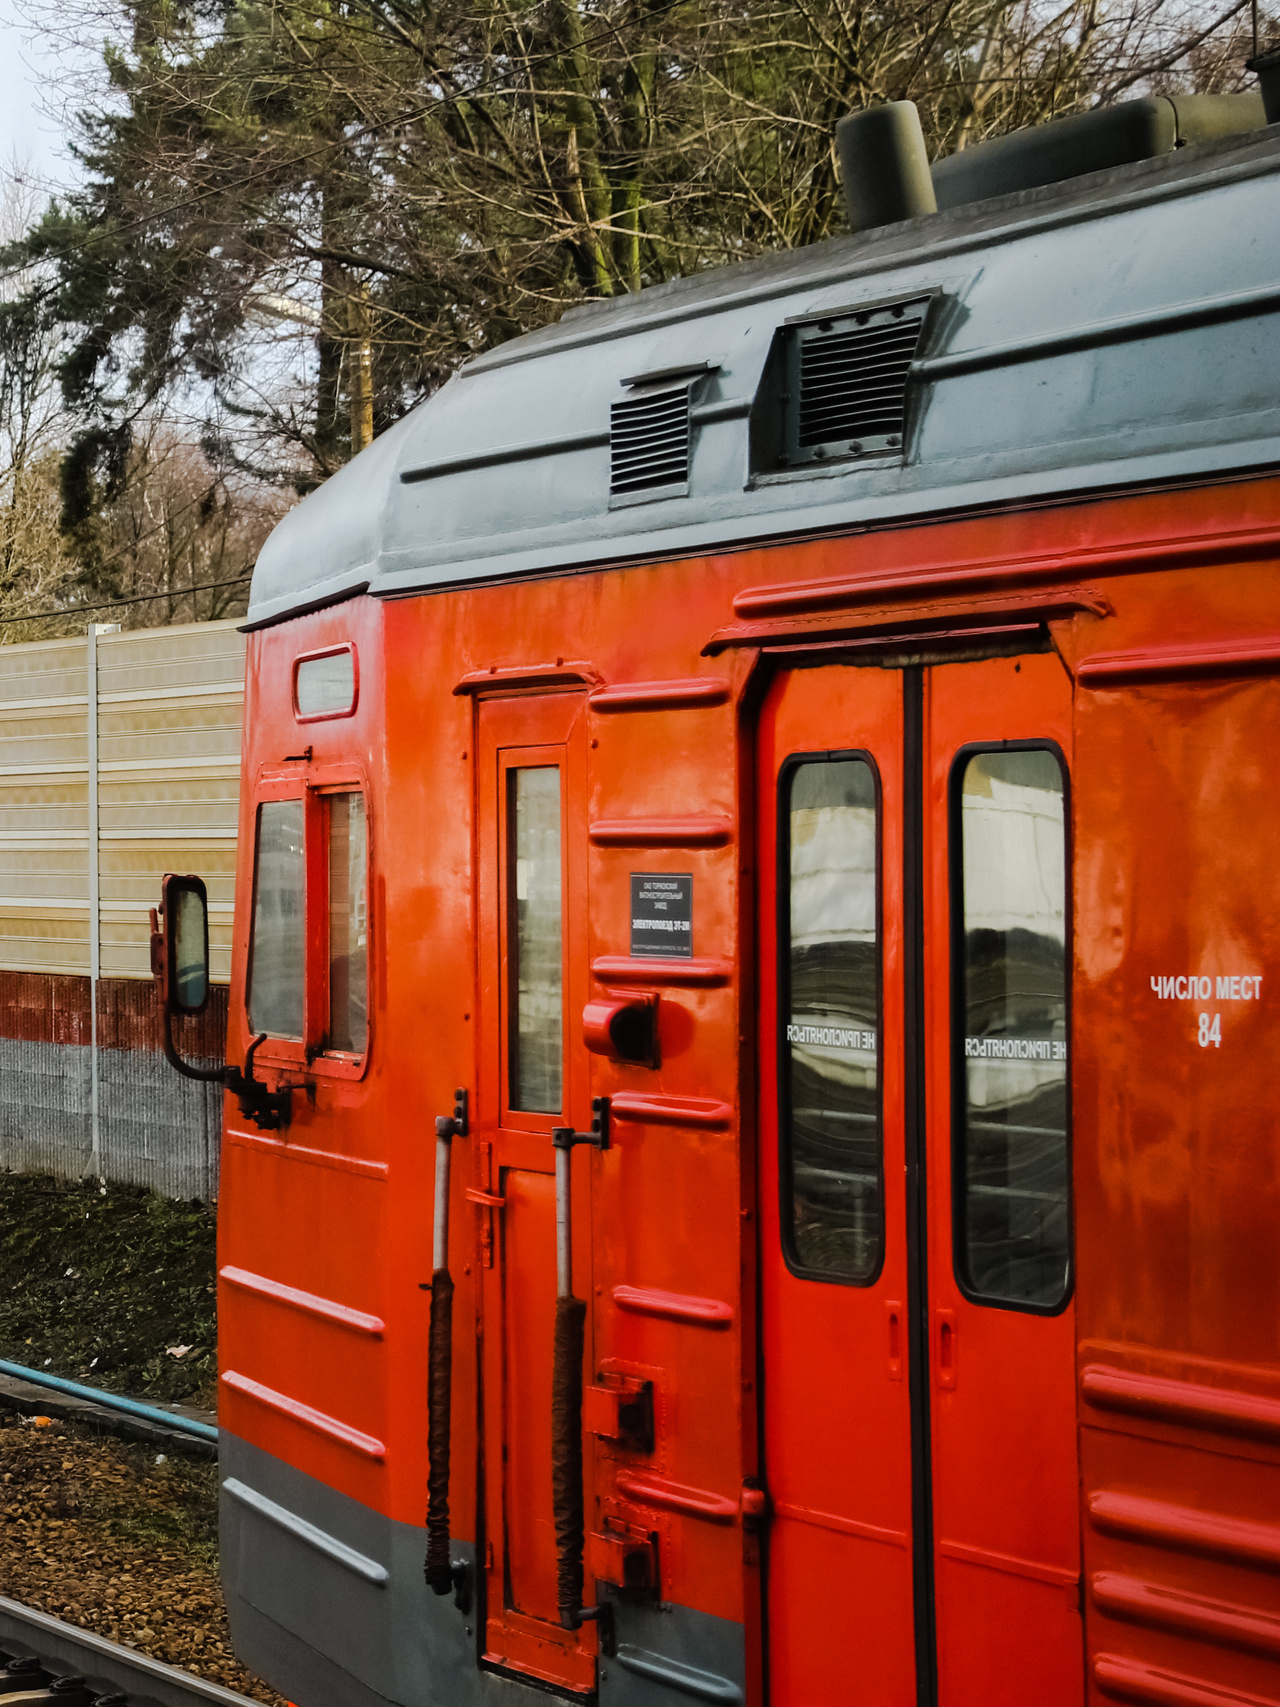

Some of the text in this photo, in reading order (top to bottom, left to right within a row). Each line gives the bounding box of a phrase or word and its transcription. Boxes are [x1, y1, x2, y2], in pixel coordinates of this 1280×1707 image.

[632, 918, 674, 932] ЭЛЕКТРОПОЕЗД
[1150, 975, 1263, 1000] ЧИСЛО МЕСТ
[1197, 1012, 1222, 1048] 84
